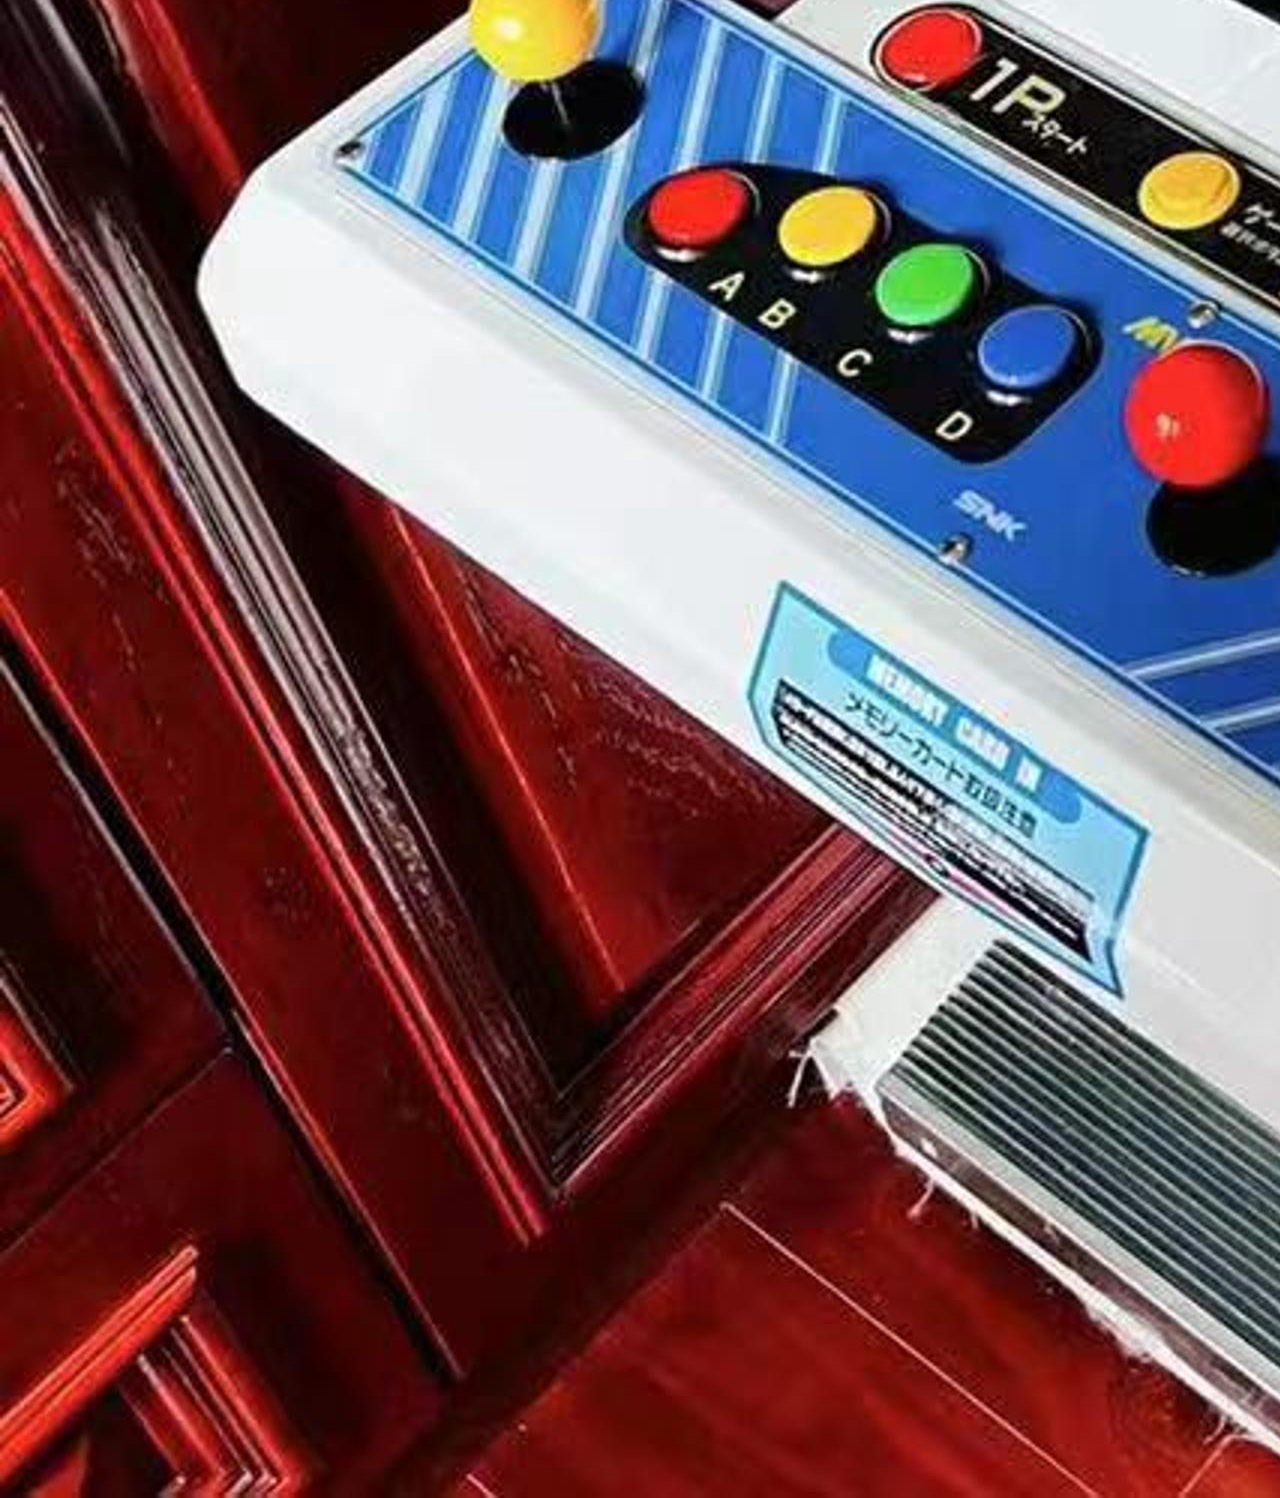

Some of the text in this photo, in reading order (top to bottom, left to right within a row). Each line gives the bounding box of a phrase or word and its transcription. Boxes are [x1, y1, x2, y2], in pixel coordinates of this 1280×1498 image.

[969, 54, 1068, 114] 1P
[708, 270, 975, 441] A B C D
[952, 490, 1030, 541] SNK
